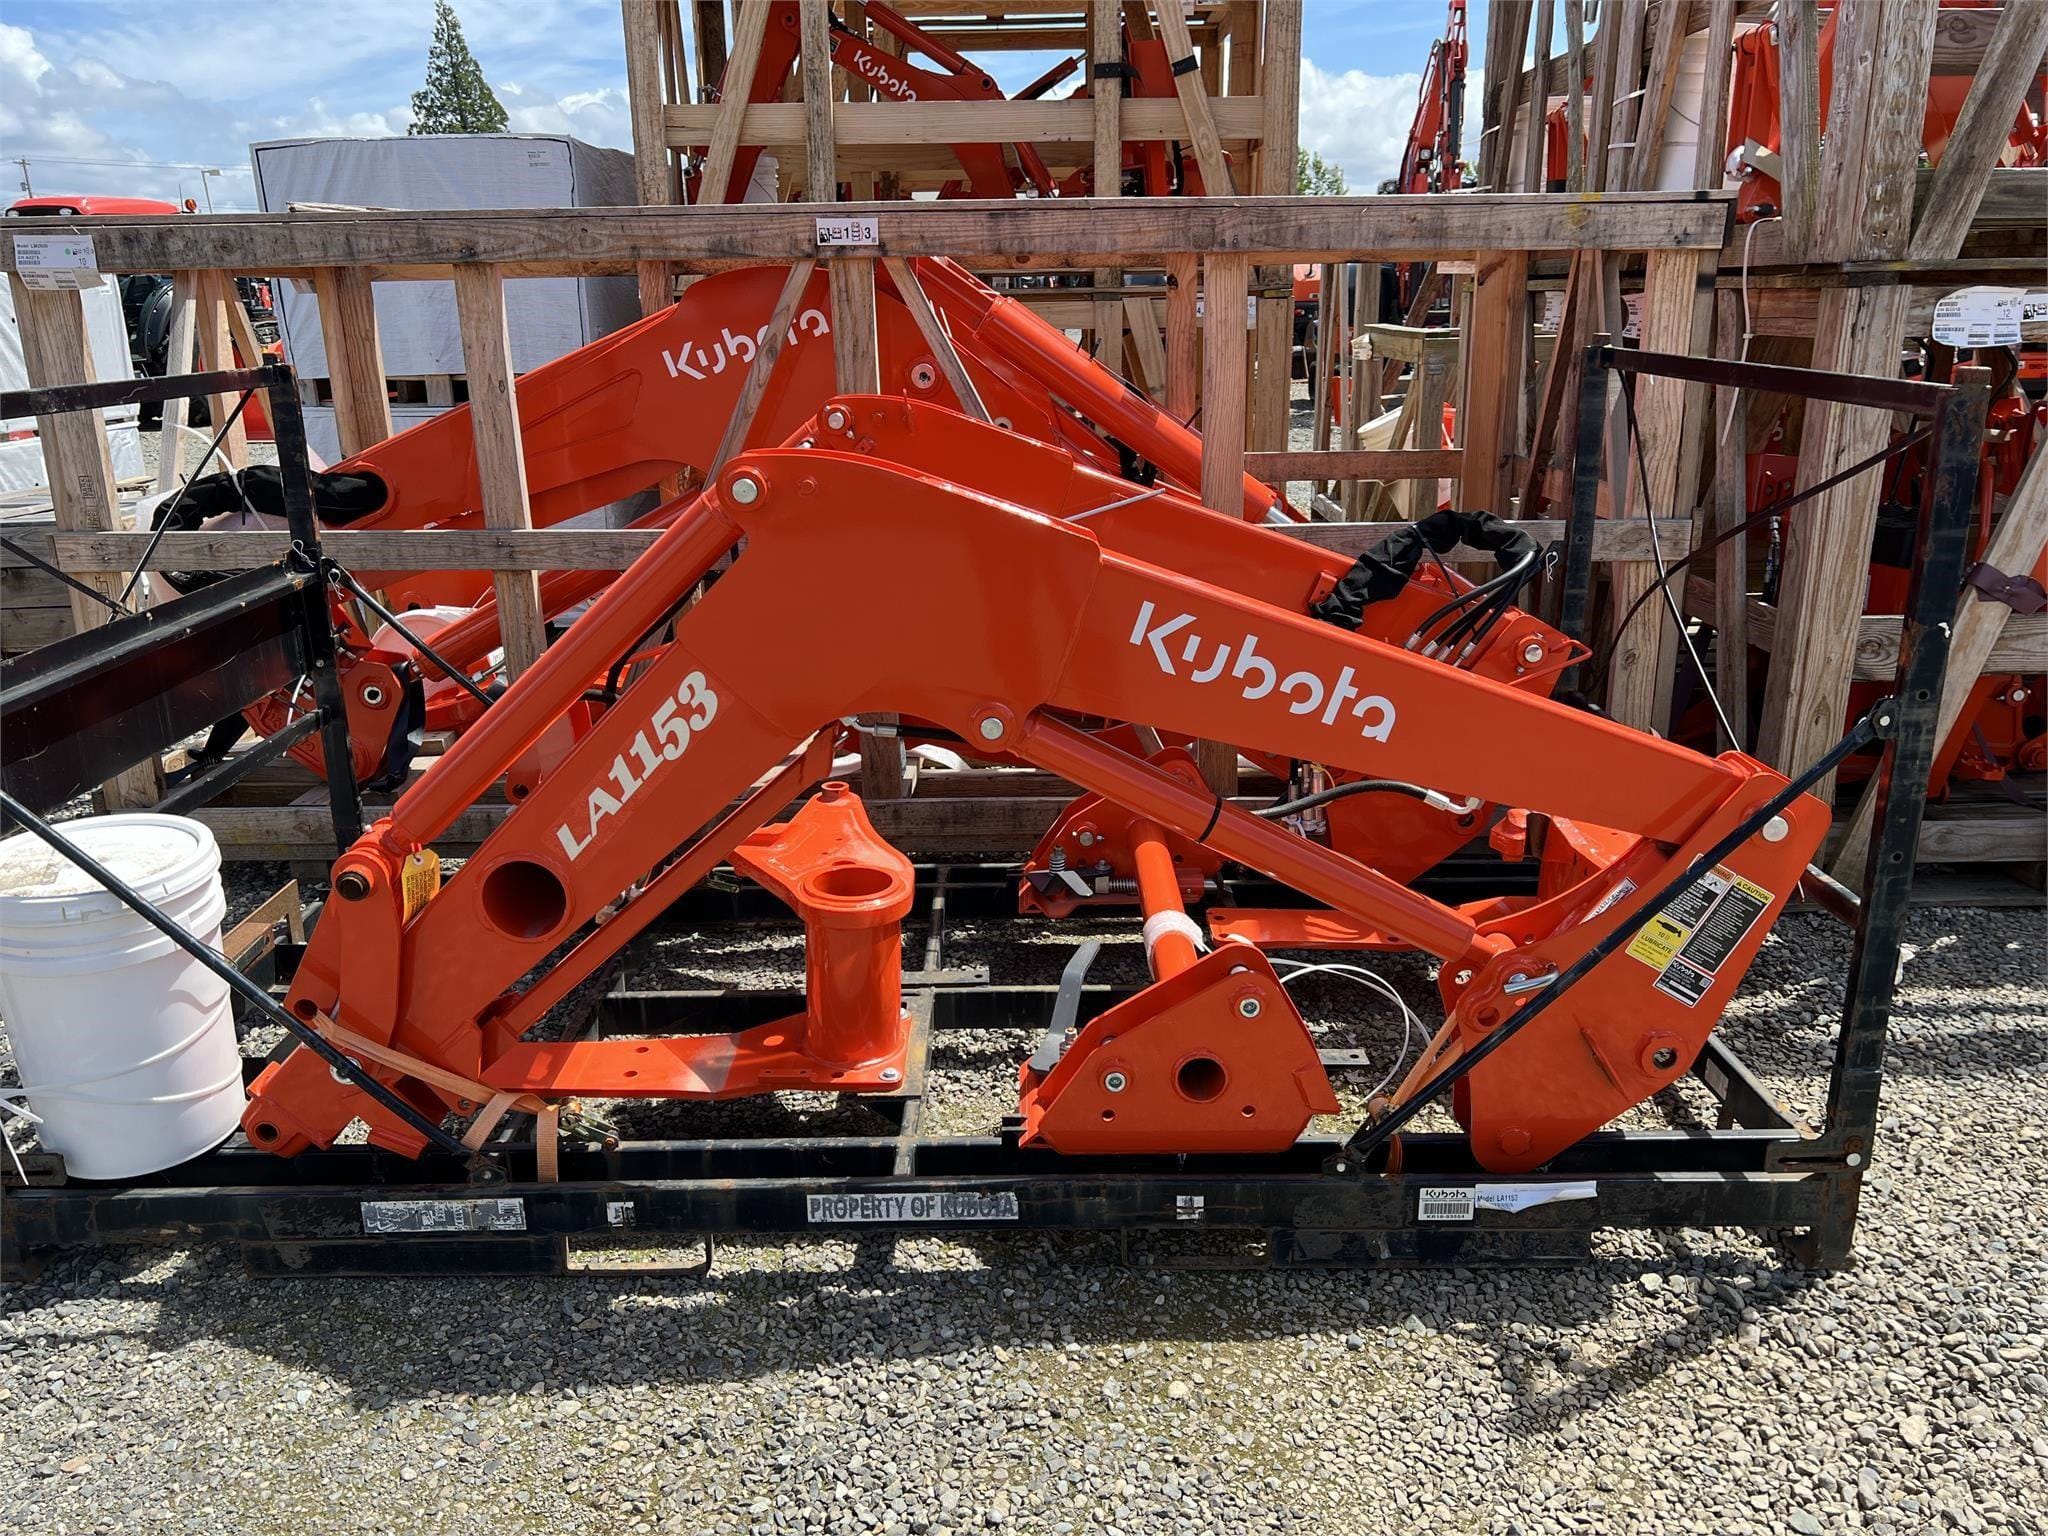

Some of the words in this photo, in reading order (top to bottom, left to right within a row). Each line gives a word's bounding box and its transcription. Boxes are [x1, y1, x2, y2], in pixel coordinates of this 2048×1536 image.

[853, 49, 917, 102] Kubota
[844, 227, 849, 239] 1
[864, 227, 872, 239] 3
[78, 257, 87, 266] 10
[2002, 309, 2011, 318] 12
[1129, 600, 1396, 743] Kubota
[556, 671, 718, 861] LA1153
[1742, 883, 1770, 902] CAUTION
[1641, 934, 1672, 954] LUBRICATE
[1673, 961, 1695, 978] Kubota
[1425, 1189, 1469, 1199] Kubota
[810, 1196, 906, 1219] PROPERTY
[910, 1196, 936, 1218] OF
